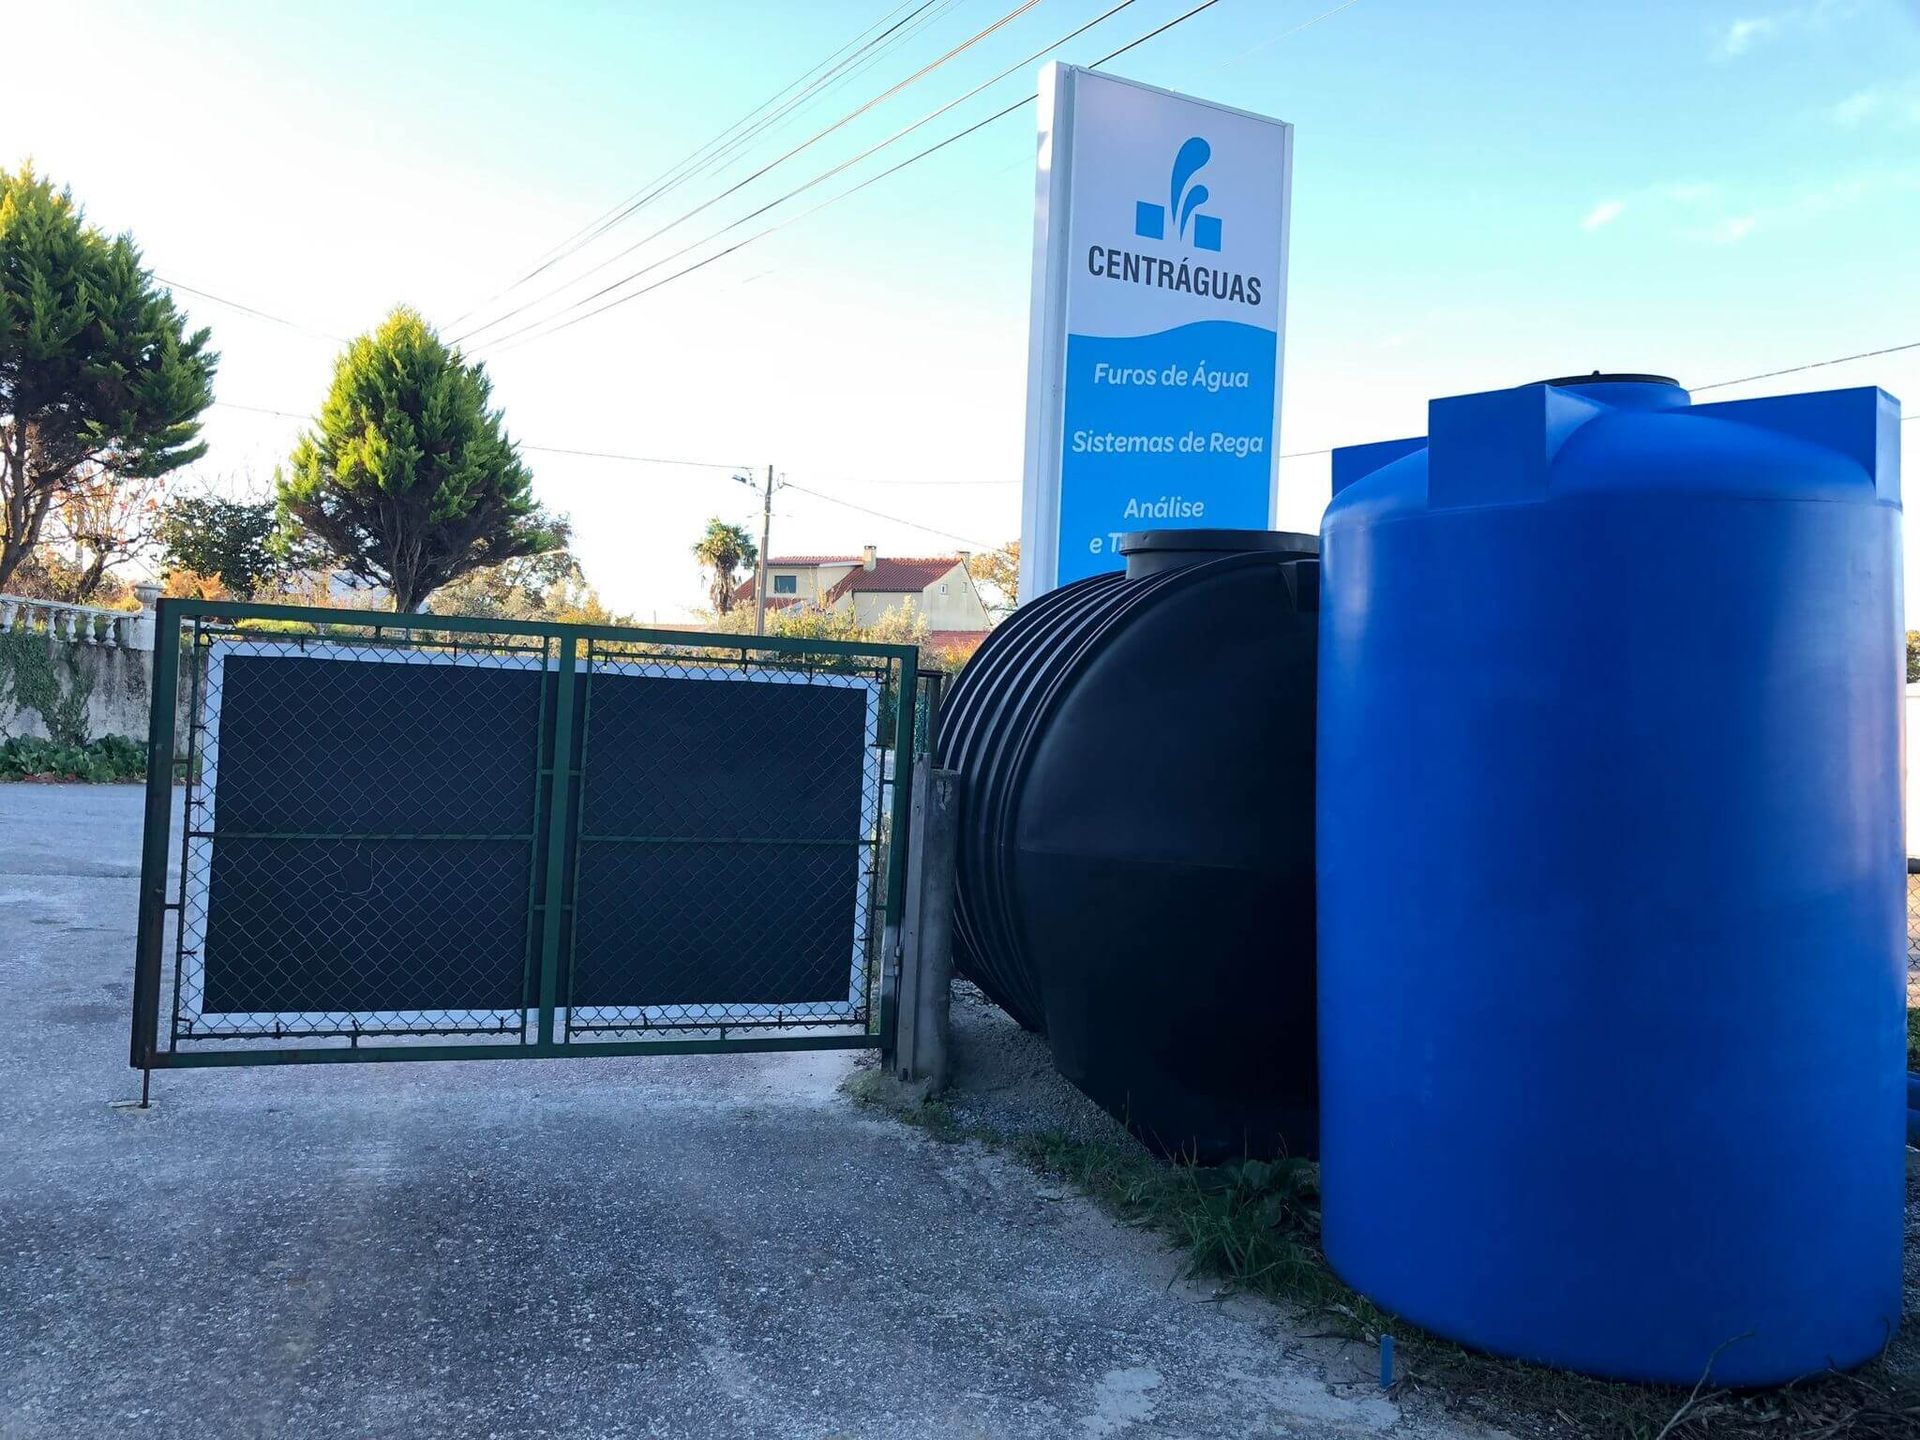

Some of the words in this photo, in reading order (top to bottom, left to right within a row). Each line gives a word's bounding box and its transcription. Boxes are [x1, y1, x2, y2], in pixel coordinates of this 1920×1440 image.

[1088, 245, 1262, 306] CENTRÁGUAS
[1094, 363, 1157, 386] Furos
[1161, 364, 1188, 386] de
[1191, 360, 1249, 393] Água
[1071, 430, 1175, 453] Sistemas
[1178, 431, 1206, 453] de
[1209, 432, 1264, 458] Rega
[1123, 496, 1205, 519] Análise
[1089, 537, 1103, 554] e
